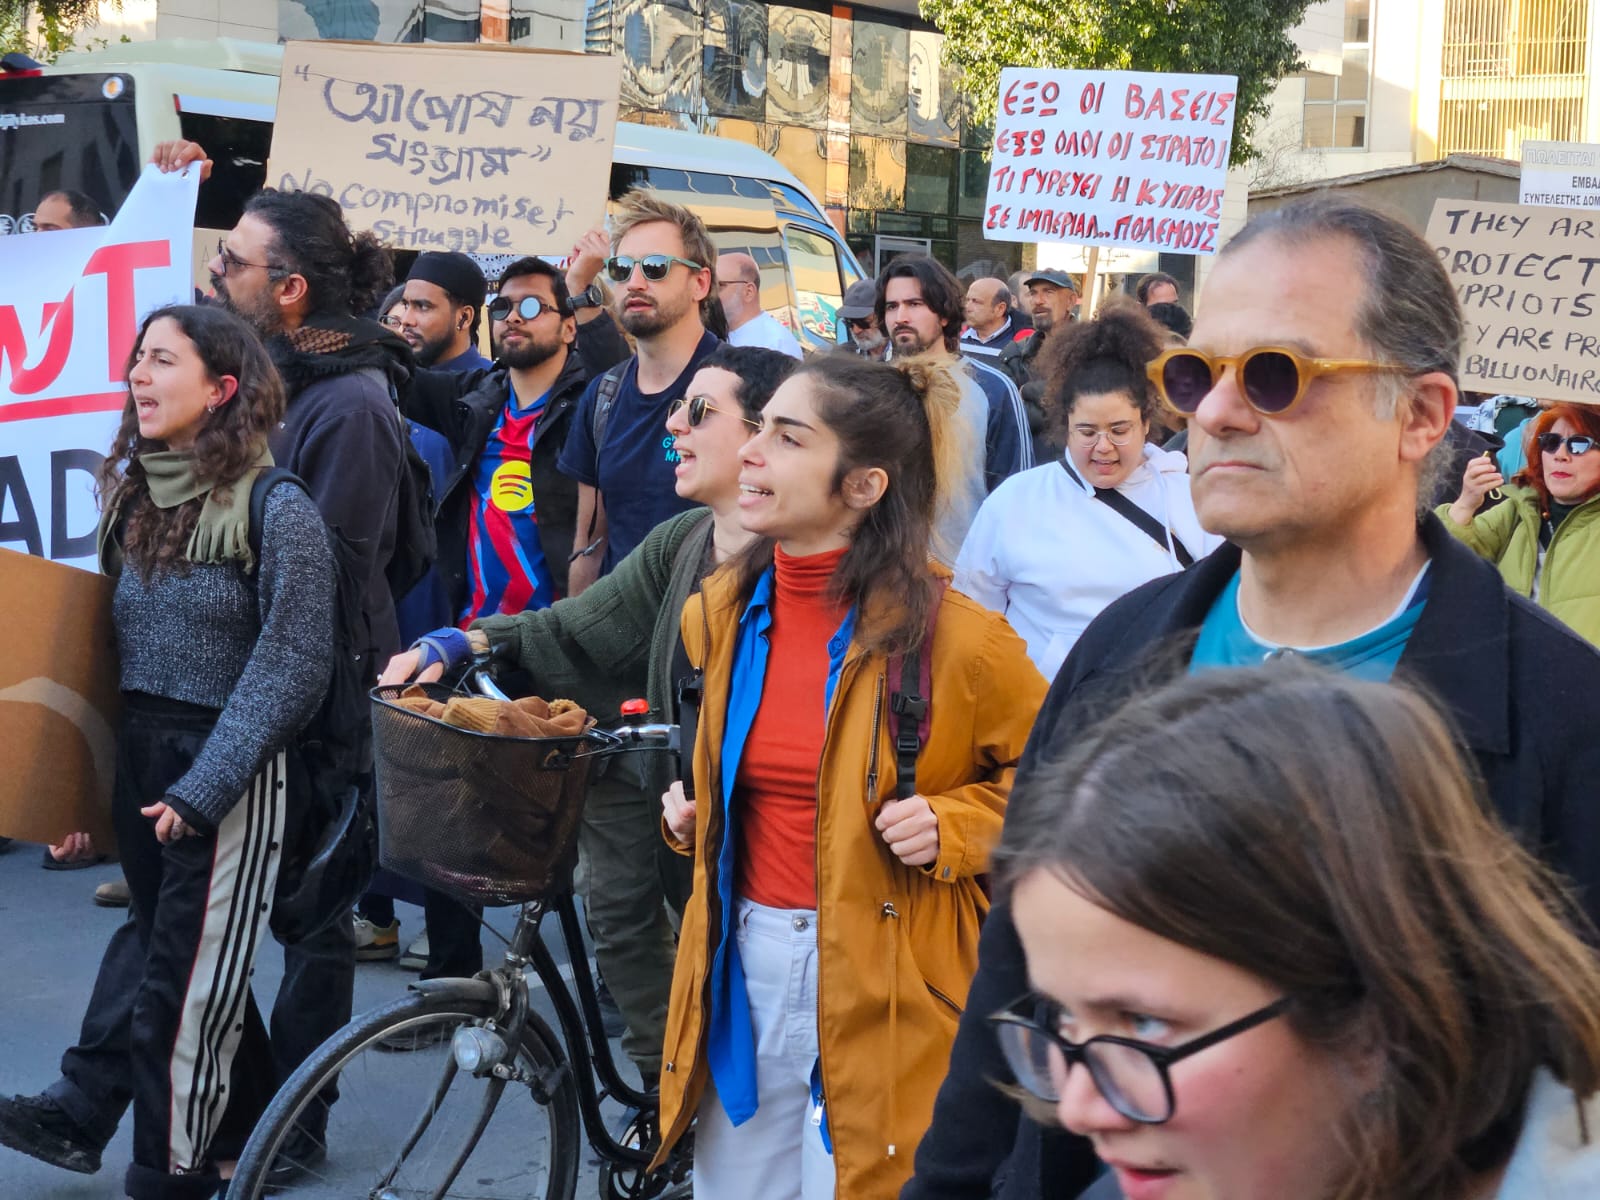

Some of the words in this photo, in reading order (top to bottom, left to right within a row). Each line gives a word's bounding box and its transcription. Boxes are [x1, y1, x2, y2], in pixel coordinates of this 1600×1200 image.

[1446, 209, 1530, 239] THEY
[1548, 216, 1600, 239] AR
[1457, 283, 1596, 318] PRIOTS
[1496, 326, 1554, 352] ARE
